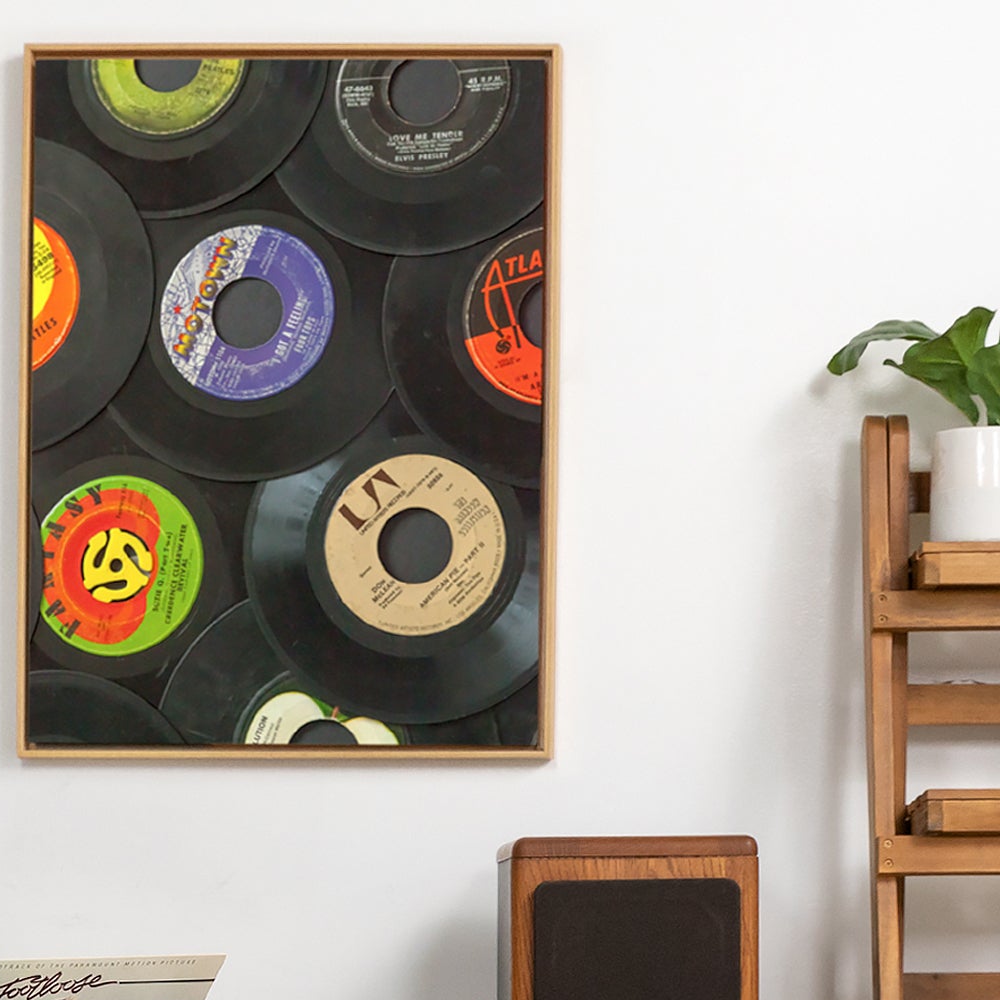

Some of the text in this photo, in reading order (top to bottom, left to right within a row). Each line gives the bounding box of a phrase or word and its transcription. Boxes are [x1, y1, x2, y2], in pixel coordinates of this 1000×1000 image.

[389, 134, 411, 142] LOVE
[418, 152, 449, 160] PRESLEY
[173, 236, 237, 361] MOTOWN
[274, 339, 289, 356] GOT
[419, 576, 449, 608] AMERICAN
[463, 547, 479, 563] PART
[371, 579, 386, 593] DON
